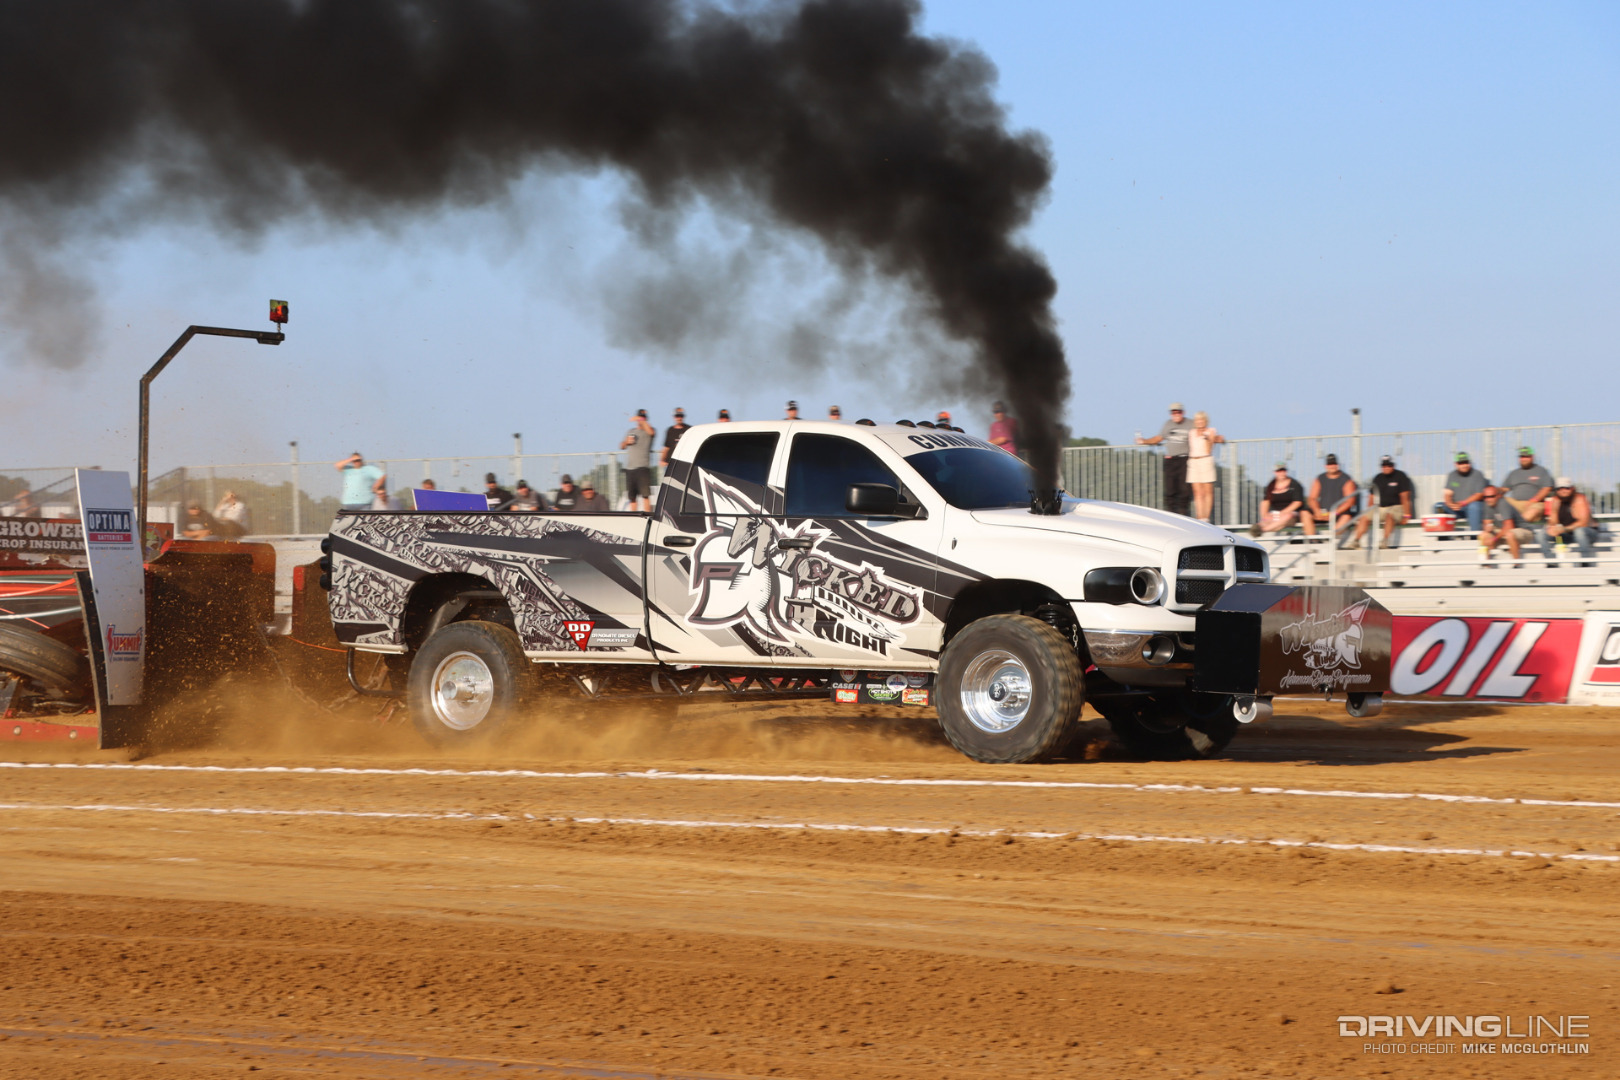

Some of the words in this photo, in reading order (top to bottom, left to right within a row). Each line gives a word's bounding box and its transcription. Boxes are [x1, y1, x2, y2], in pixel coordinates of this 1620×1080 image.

[88, 513, 130, 530] OPTIMA
[0, 539, 27, 548] ROP
[1390, 618, 1550, 699] OIL
